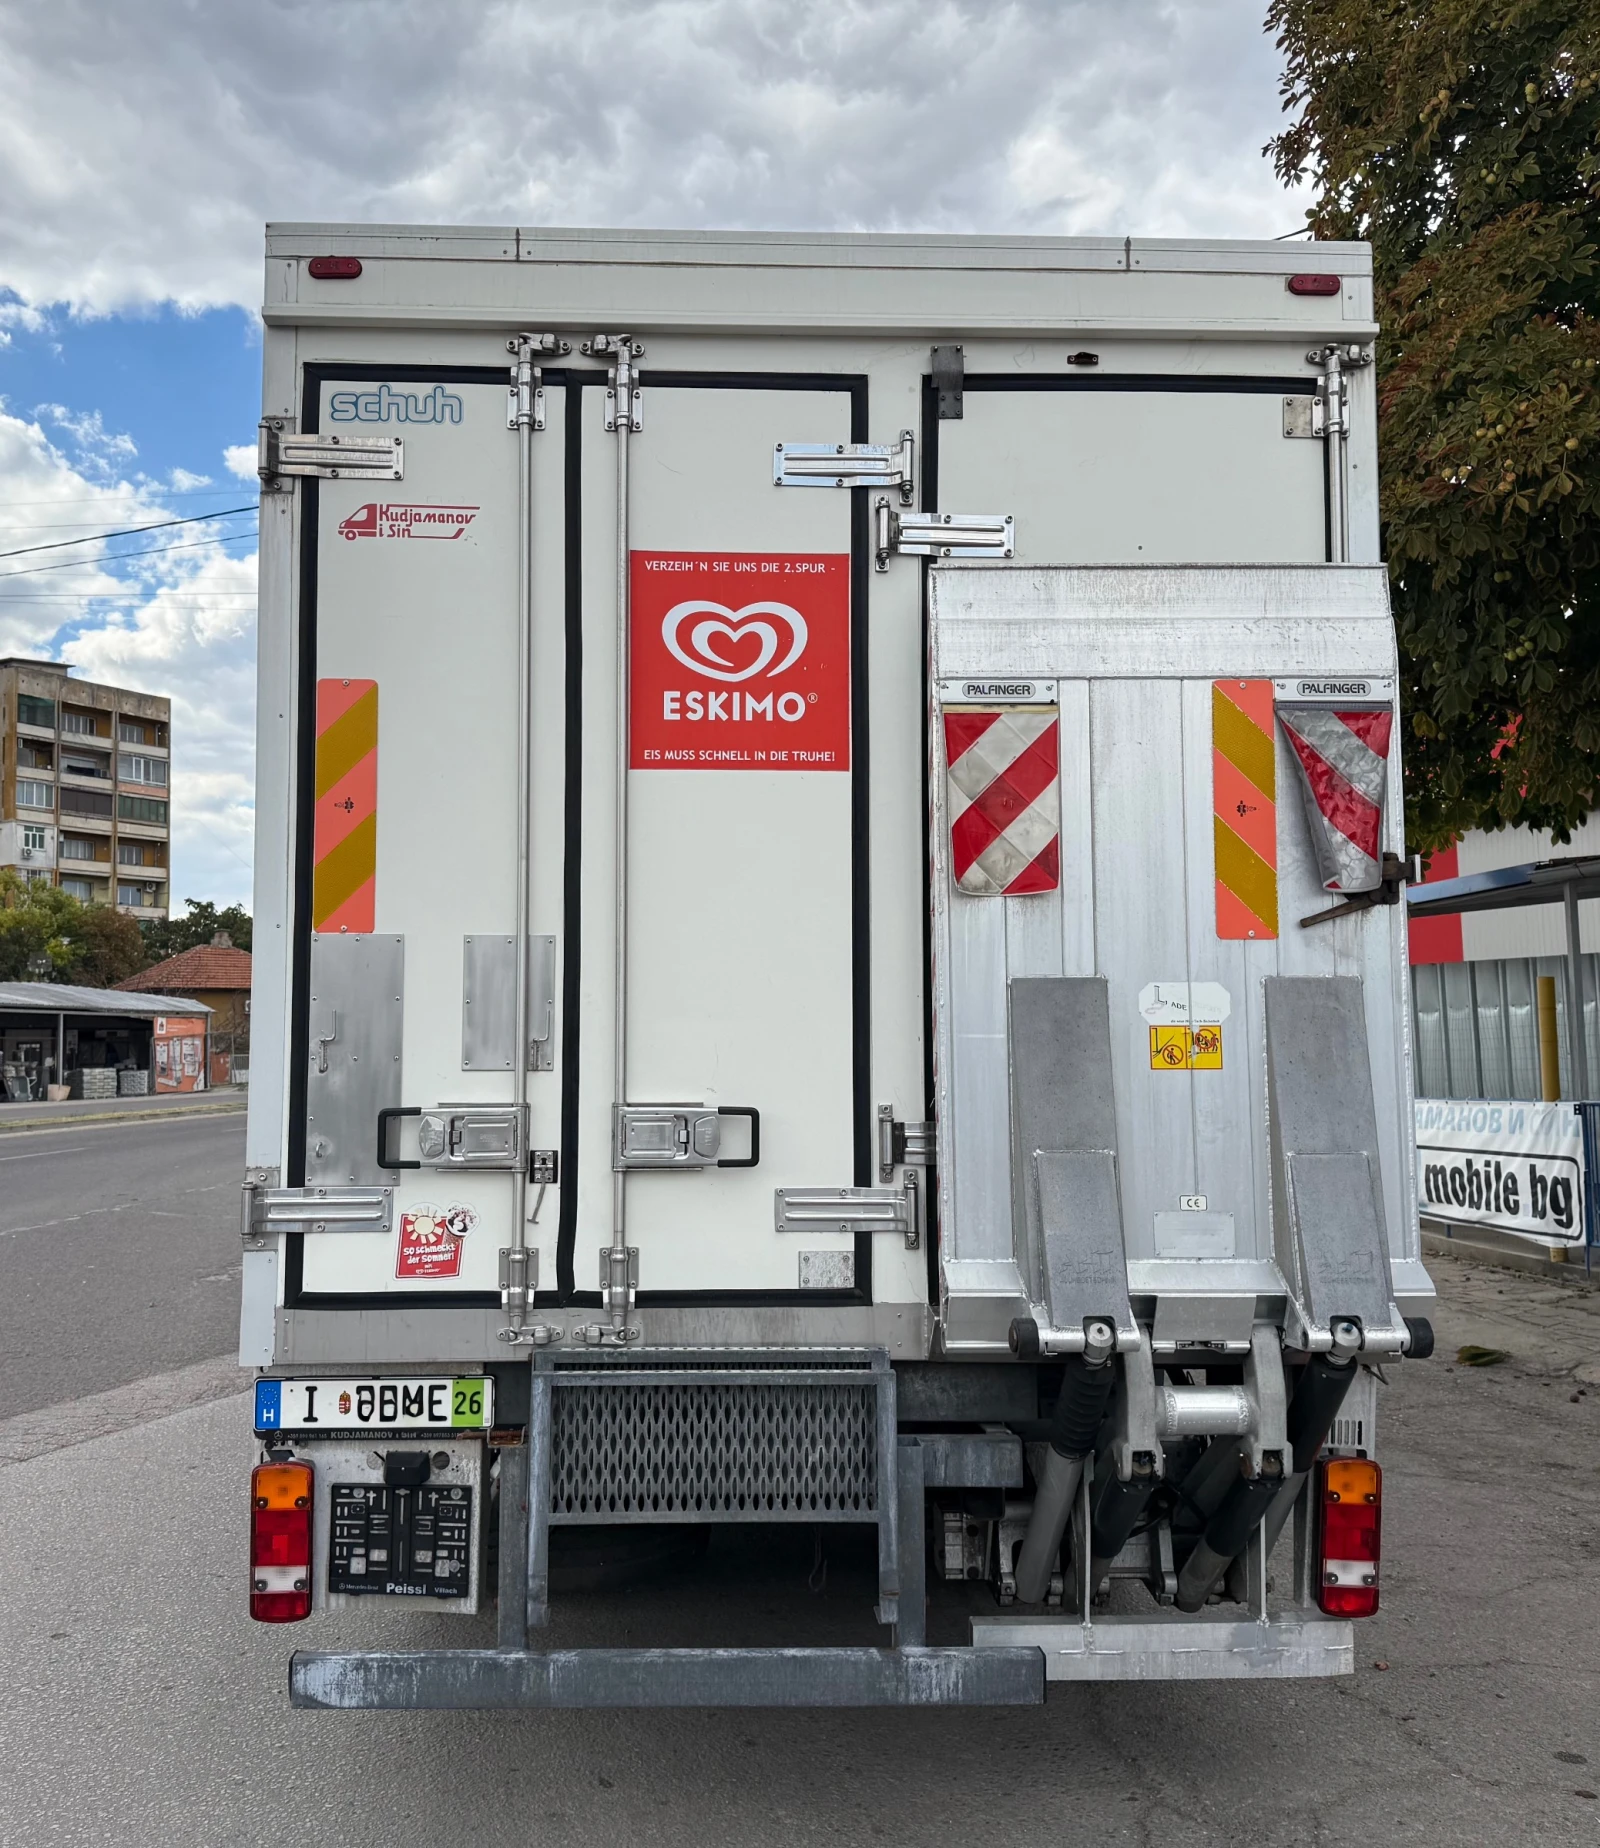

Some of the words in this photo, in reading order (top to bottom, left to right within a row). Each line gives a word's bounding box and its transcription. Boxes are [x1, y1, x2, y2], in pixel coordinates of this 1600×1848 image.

[330, 384, 463, 425] schuh
[379, 504, 477, 528] Kudjamanov
[379, 524, 385, 538] i
[387, 524, 411, 538] Sin
[713, 562, 730, 572] SIE
[734, 562, 757, 573] UNS
[761, 563, 780, 573] DIE
[784, 563, 825, 574] 2.SPUR
[967, 684, 1031, 695] PALFINGER
[1302, 683, 1366, 694] PALFINGER
[644, 750, 661, 760] EIS
[665, 750, 695, 760] MUSS
[699, 750, 751, 761] SCHNELL
[754, 751, 766, 761] IN
[770, 751, 788, 761] DIE
[792, 751, 835, 762] TRUHE!
[454, 1391, 481, 1416] 26
[263, 1408, 275, 1422] H
[330, 1431, 393, 1439] KUDJAMANOV
[386, 1582, 427, 1595] Peissl
